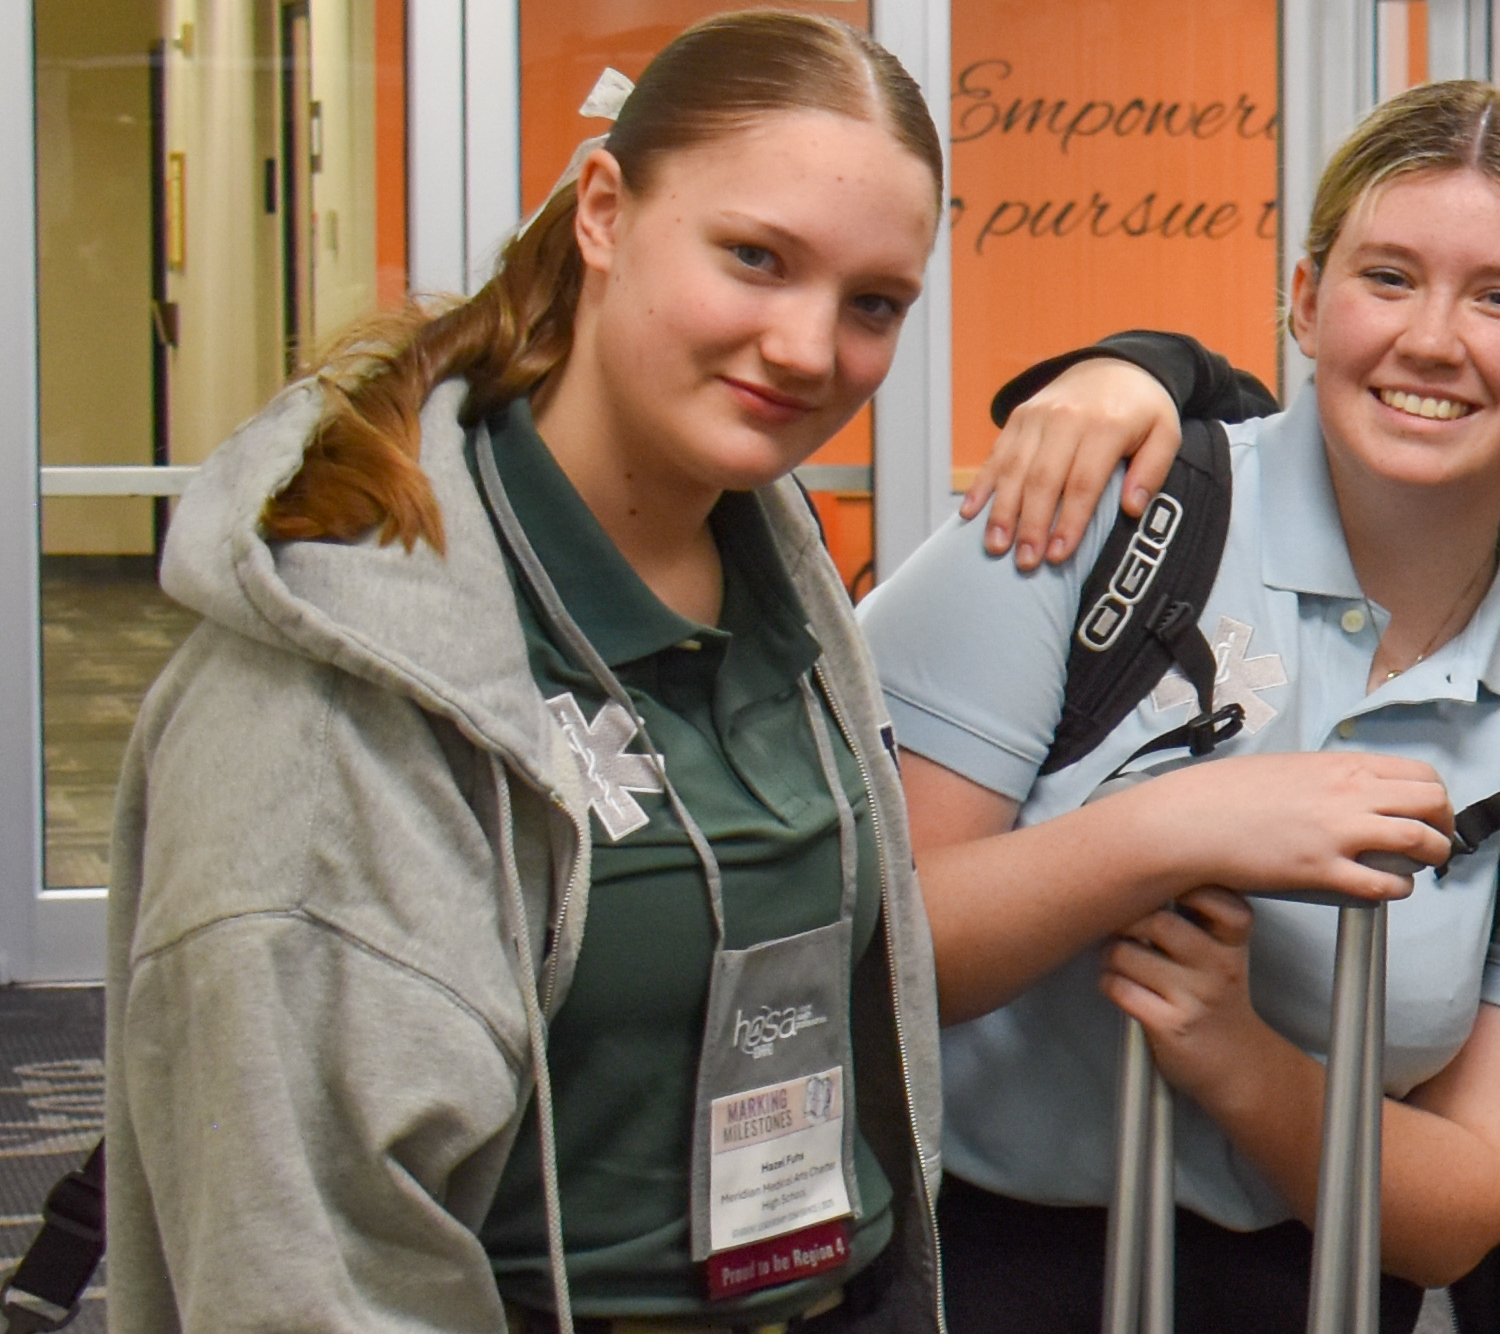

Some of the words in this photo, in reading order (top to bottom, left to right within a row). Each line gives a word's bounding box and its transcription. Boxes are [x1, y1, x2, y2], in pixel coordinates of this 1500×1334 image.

[975, 188, 1240, 251] pursue
[1078, 492, 1184, 652] OGIO
[734, 1007, 798, 1048] hosa
[727, 1088, 788, 1123] MARKING
[723, 1109, 793, 1144] MILESTONES
[792, 1243, 835, 1267] Region
